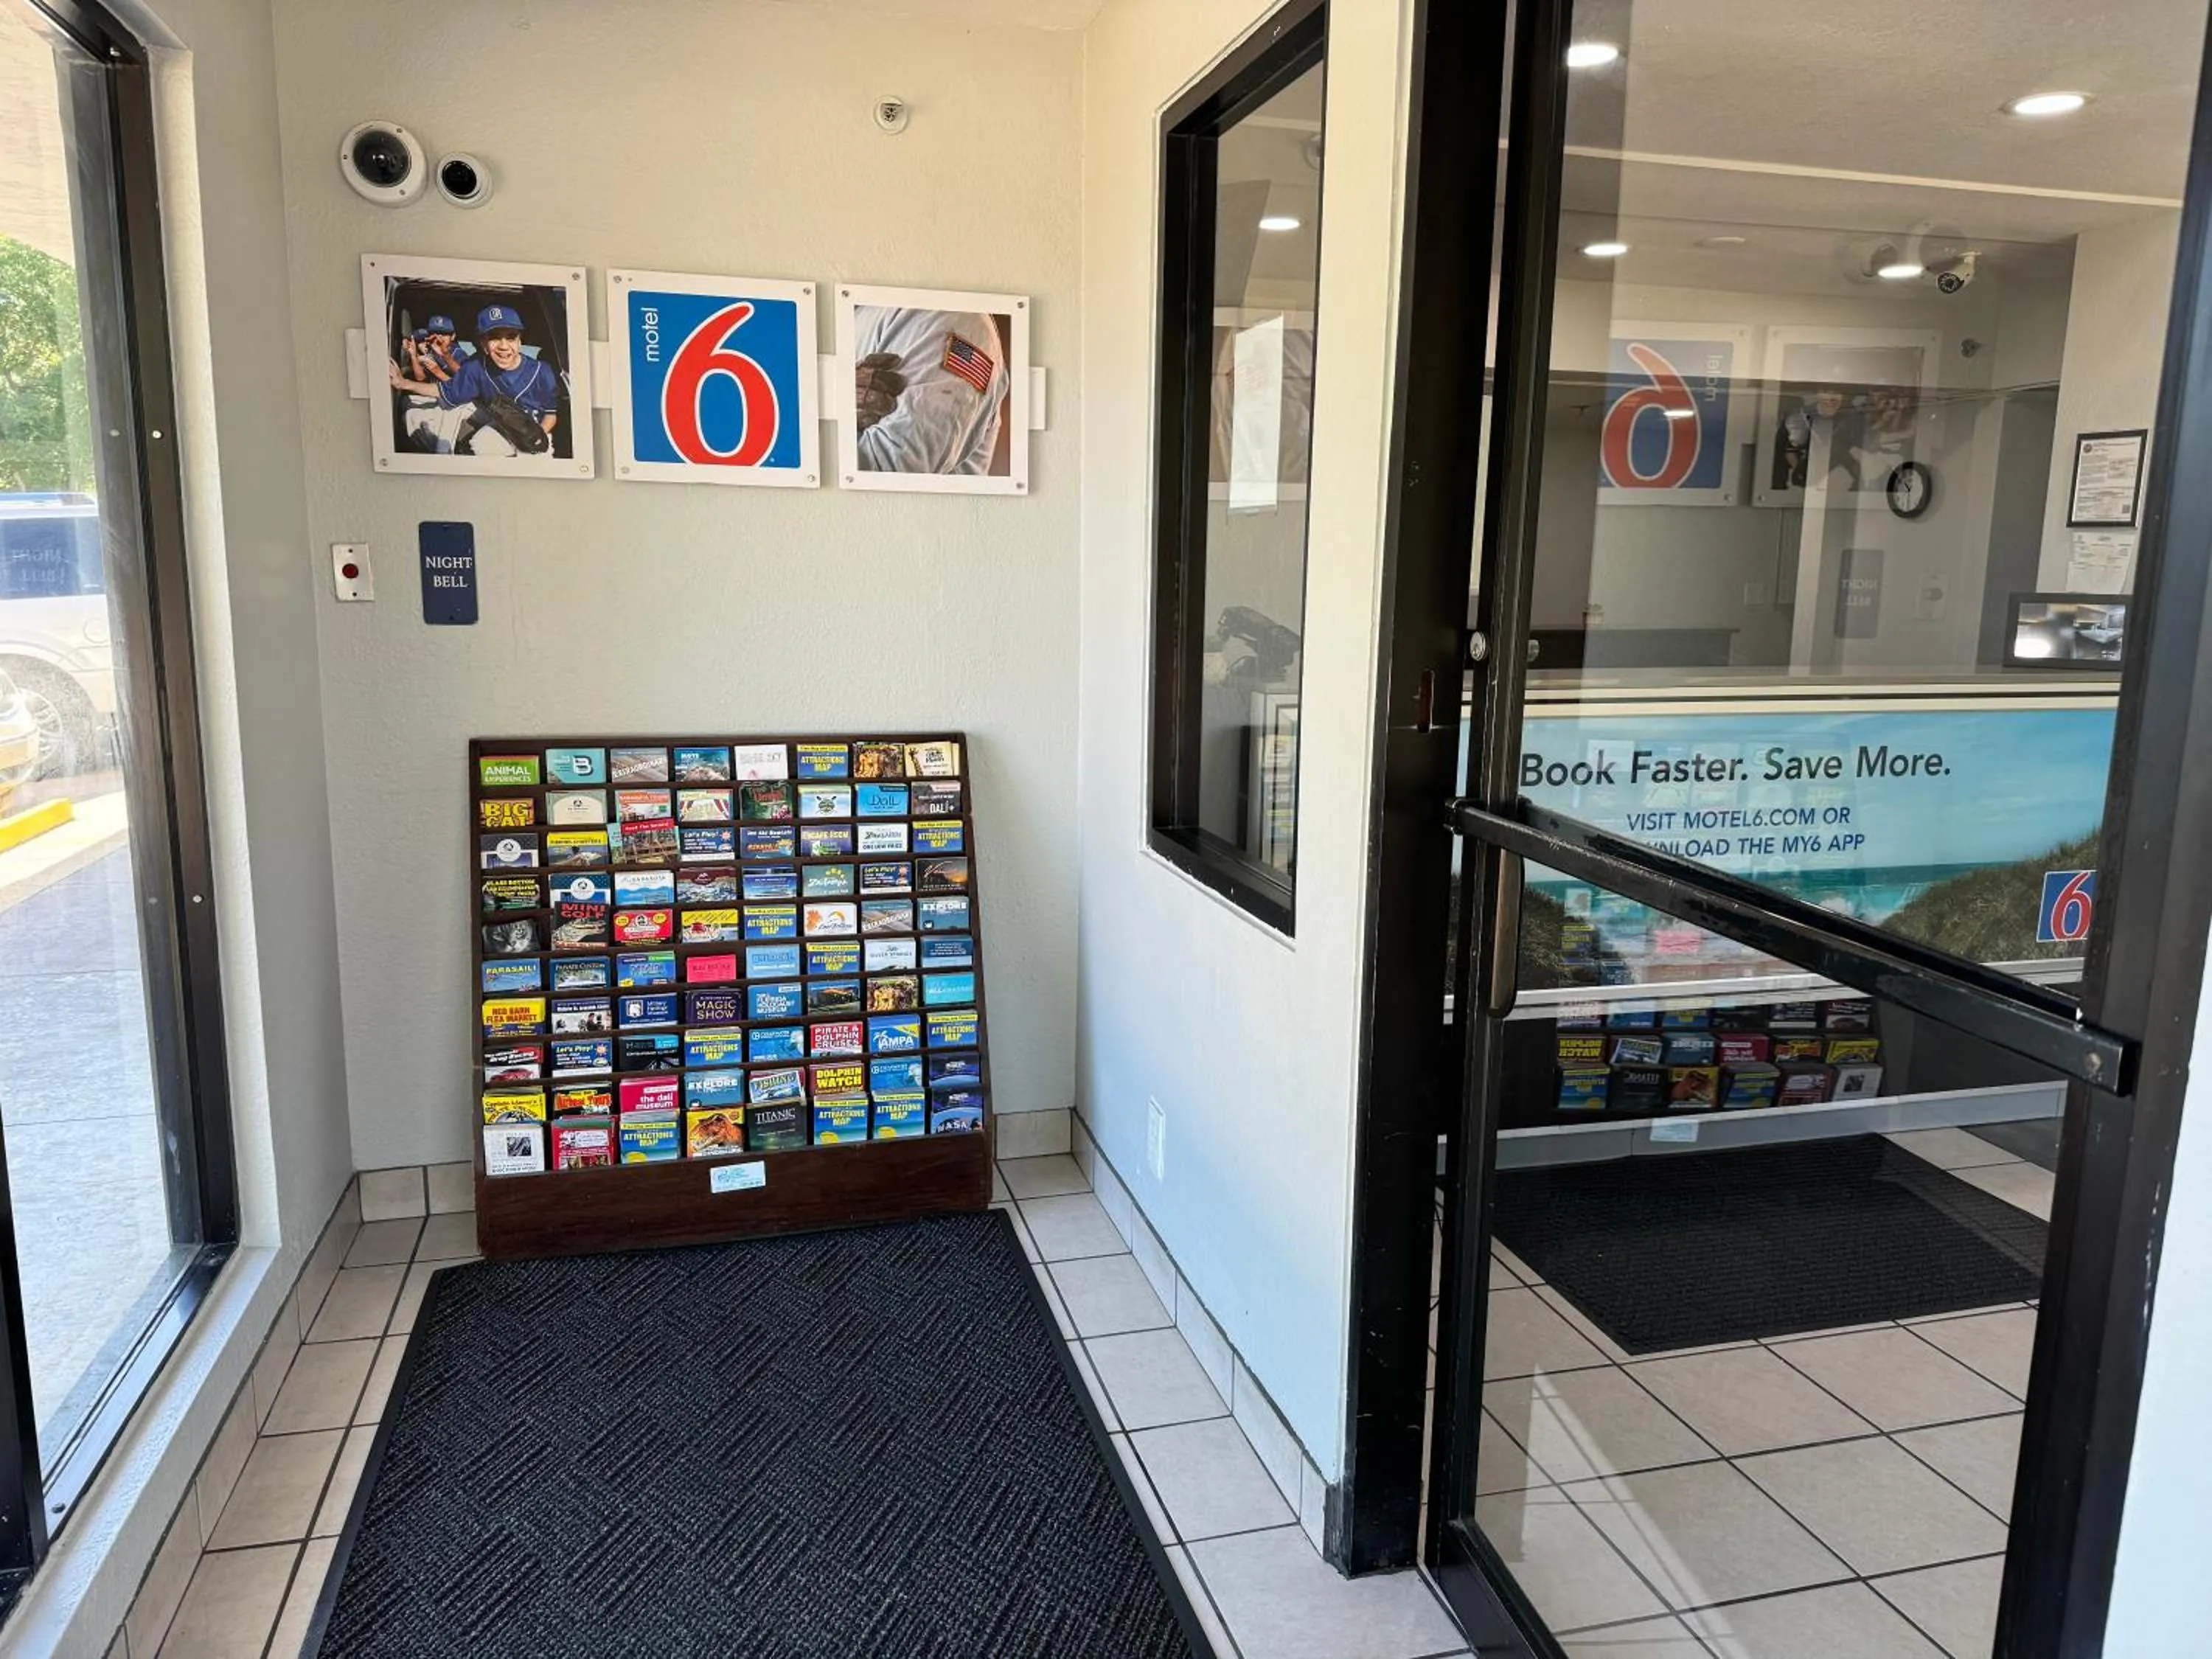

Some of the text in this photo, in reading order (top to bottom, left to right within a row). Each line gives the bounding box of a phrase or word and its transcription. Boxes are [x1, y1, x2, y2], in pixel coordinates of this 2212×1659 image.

[641, 307, 661, 363] motel
[661, 301, 780, 467] 6
[425, 555, 473, 569] NIGHT
[433, 575, 468, 588] BELL
[485, 766, 531, 775] ANIMAL
[1519, 745, 1952, 787] Book Faster. Save More.
[484, 802, 529, 816] BIG
[485, 816, 526, 827] CAT
[1627, 807, 1851, 831] VISIT MOTEL6.COM OR
[1738, 836, 1775, 855] THE
[1782, 835, 1822, 853] MY6
[1827, 833, 1865, 852] APP
[560, 903, 605, 911] MINI
[2051, 871, 2093, 941] 6
[492, 1006, 530, 1015] RED BARN
[695, 1000, 737, 1010] MAGIC
[486, 1014, 538, 1023] FLEA MARKET
[697, 1009, 734, 1020] SHOW
[815, 1026, 848, 1034] PIRATE
[815, 1032, 859, 1042] DOLPHIN
[815, 1040, 859, 1048] CRUISES
[816, 1067, 862, 1078] DOLPHIN
[816, 1076, 862, 1088] WATCH
[636, 1101, 673, 1110] museum
[877, 1103, 922, 1113] ATTRACTIONS
[755, 1108, 796, 1124] TITANIC
[818, 1110, 866, 1119] ATTRACTIONS
[937, 1120, 968, 1133] NASA
[623, 1130, 673, 1141] ATTRACTIONS
